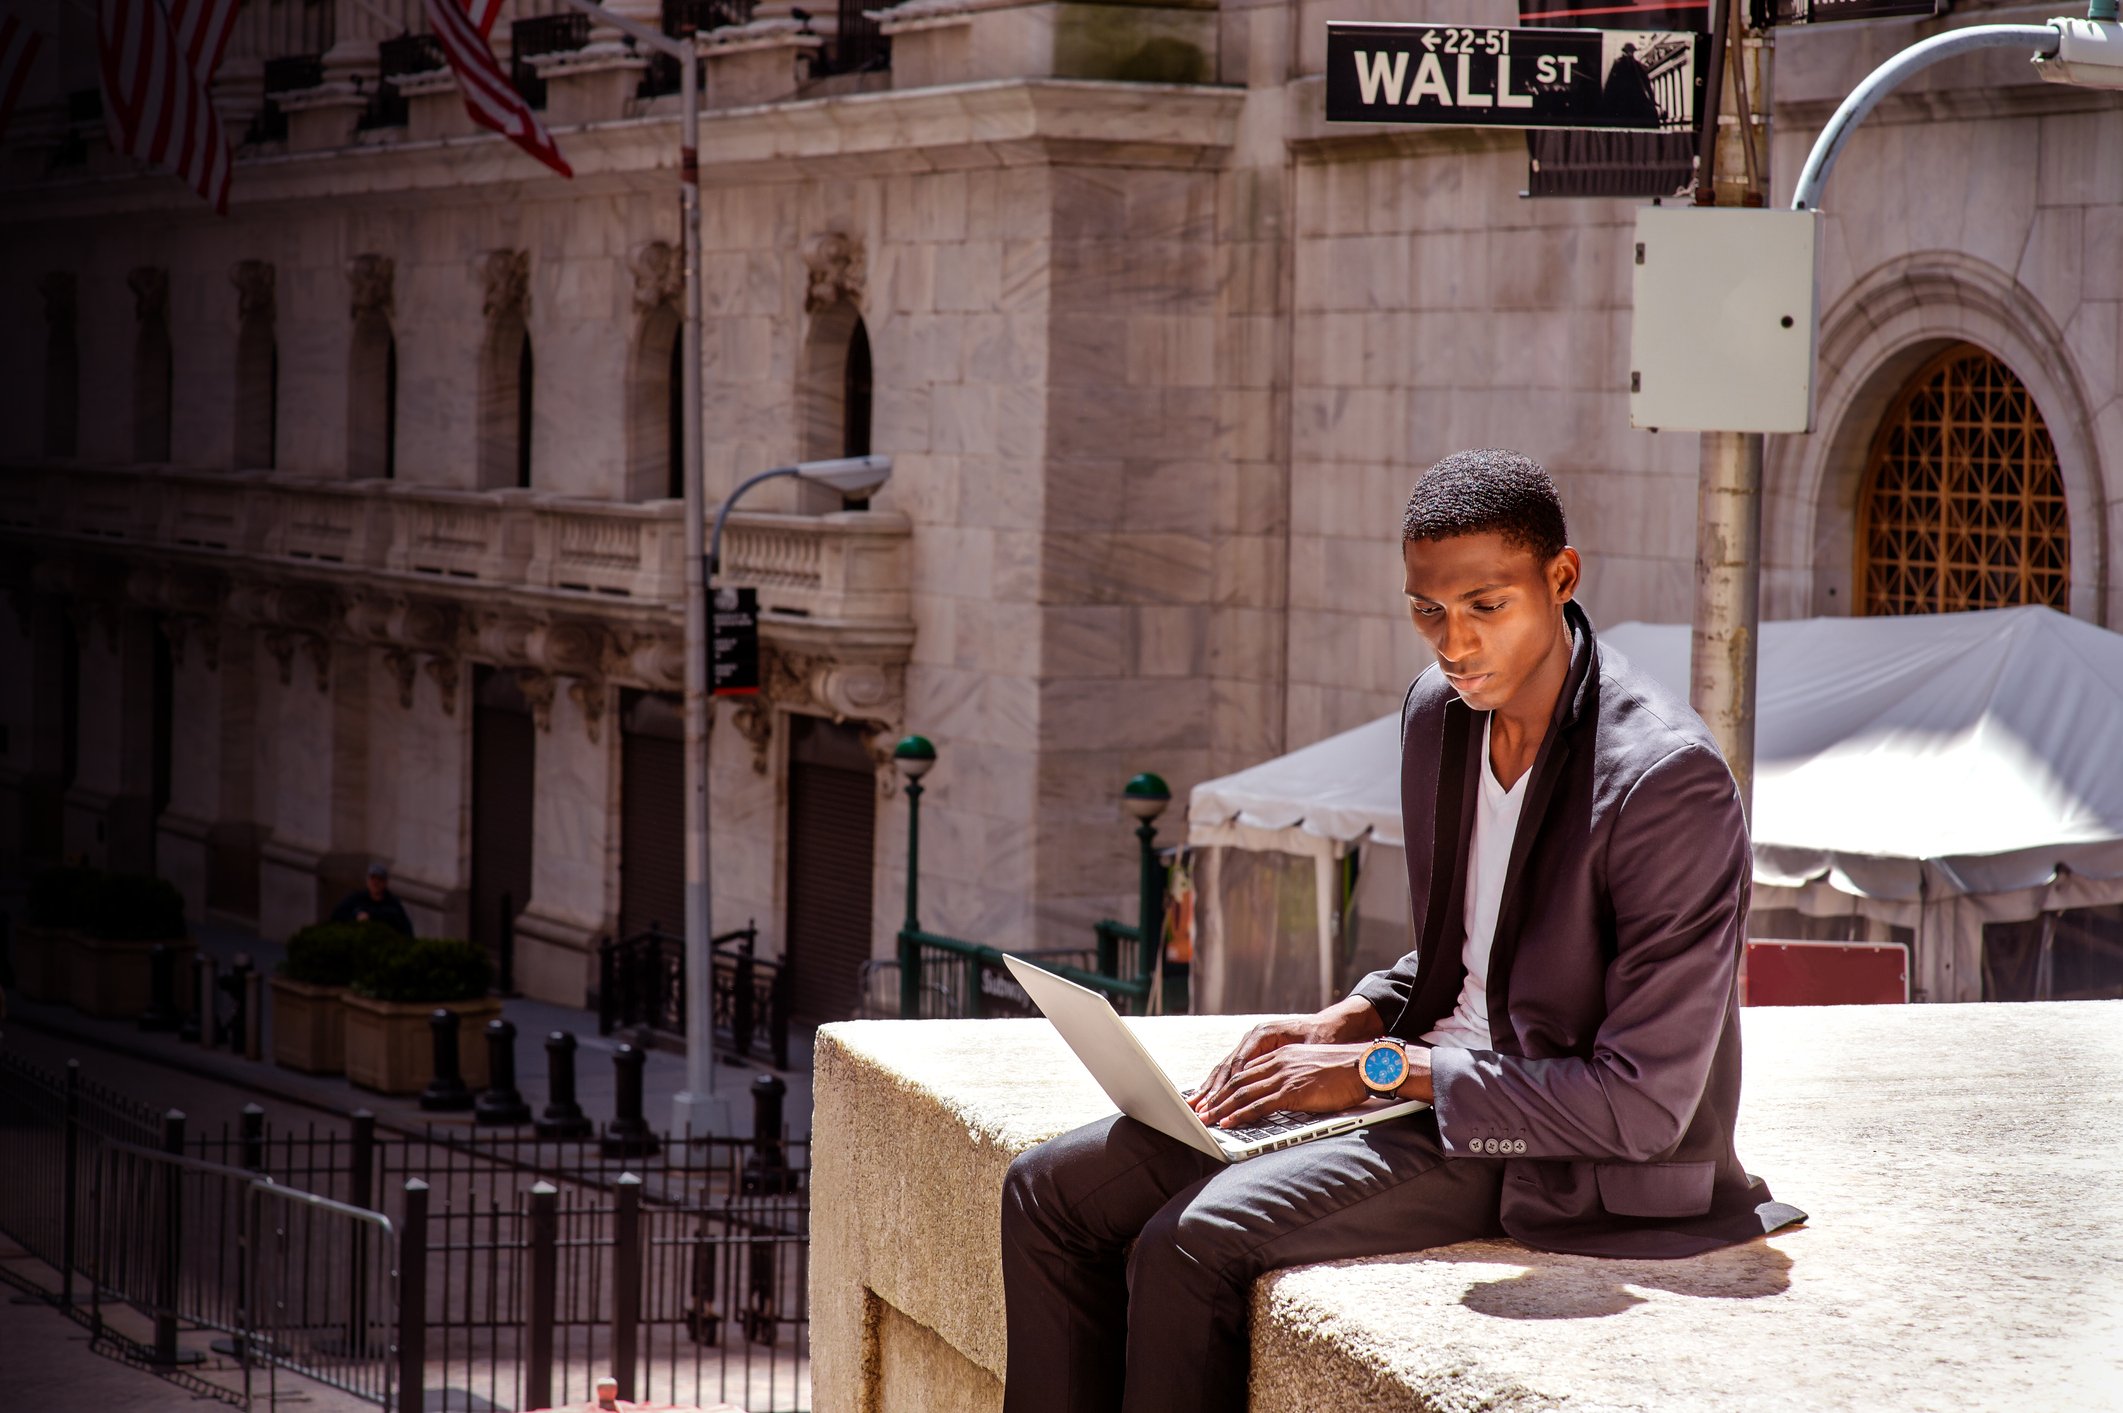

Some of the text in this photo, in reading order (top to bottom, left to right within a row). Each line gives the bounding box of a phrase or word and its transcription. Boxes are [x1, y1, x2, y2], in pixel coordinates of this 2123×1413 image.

[1444, 29, 1509, 55] 22-51
[1354, 51, 1578, 107] WALL ST
